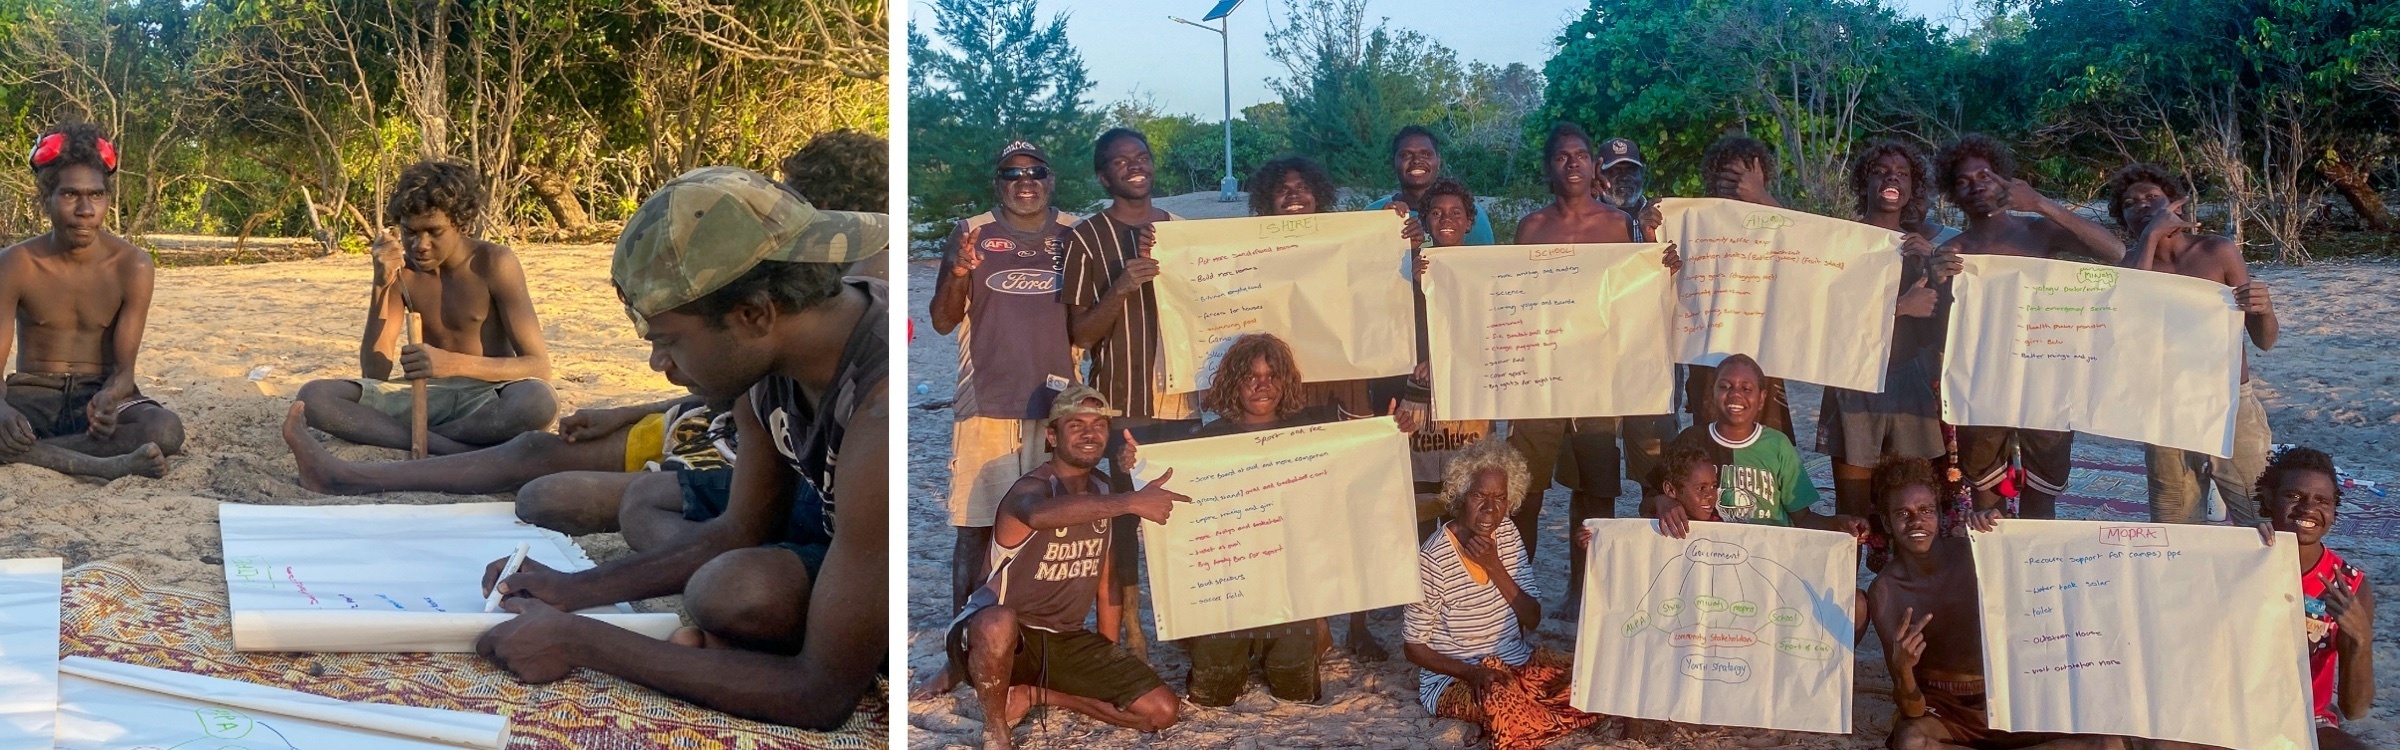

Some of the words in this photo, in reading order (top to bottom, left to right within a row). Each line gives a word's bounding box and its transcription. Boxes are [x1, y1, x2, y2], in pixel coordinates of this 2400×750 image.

[1267, 218, 1312, 233] SHIRE
[986, 240, 1012, 248] AFL
[1534, 247, 1572, 257] SCHOOL
[1001, 272, 1054, 291] Ford
[1758, 509, 1771, 519] 94
